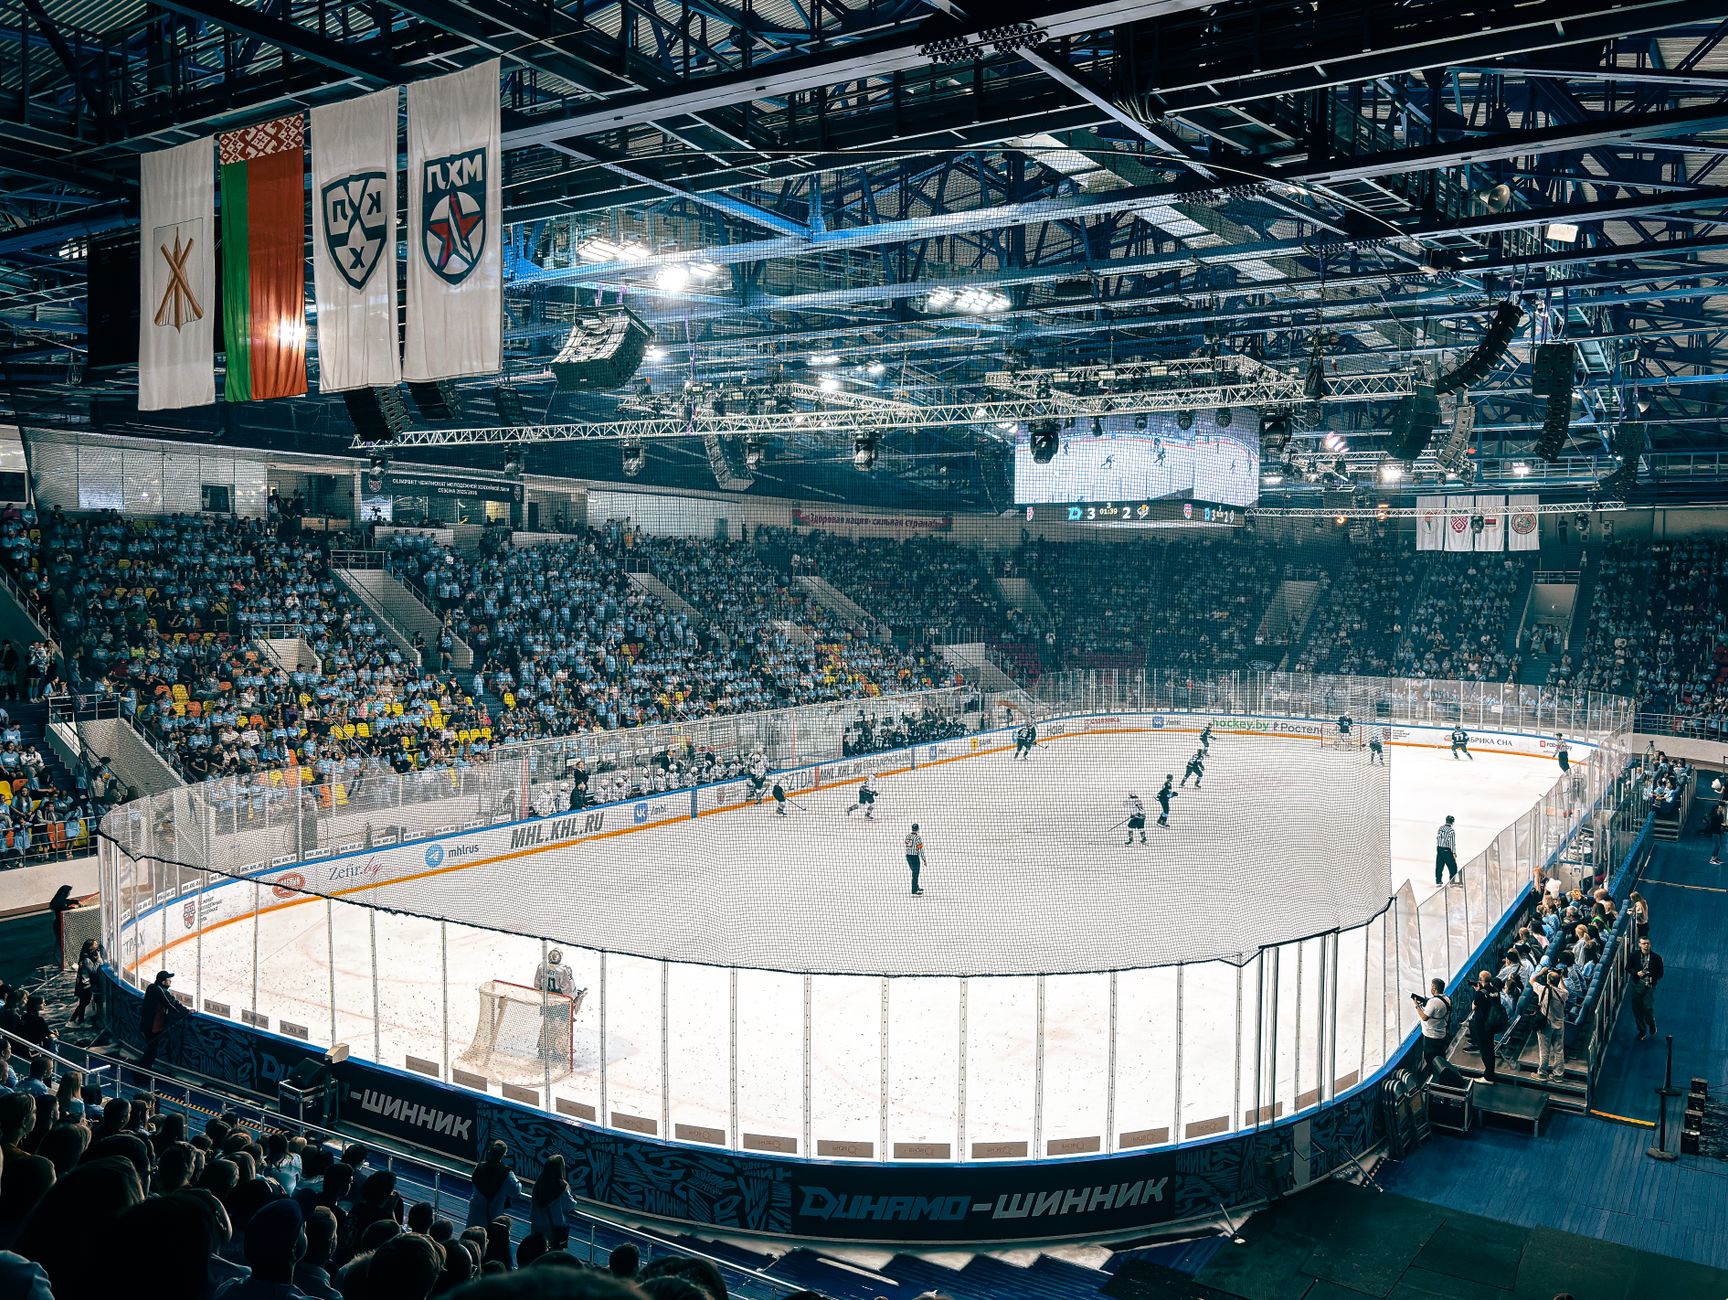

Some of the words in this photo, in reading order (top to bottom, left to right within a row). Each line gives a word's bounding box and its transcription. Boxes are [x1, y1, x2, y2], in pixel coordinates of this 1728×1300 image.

[1087, 507, 1096, 520] 3
[1122, 507, 1131, 520] 2
[1212, 718, 1269, 732] hockey.by
[510, 812, 605, 849] MHL.KHL.RU
[448, 844, 480, 858] mhlrus
[329, 856, 383, 880] Zefir.by
